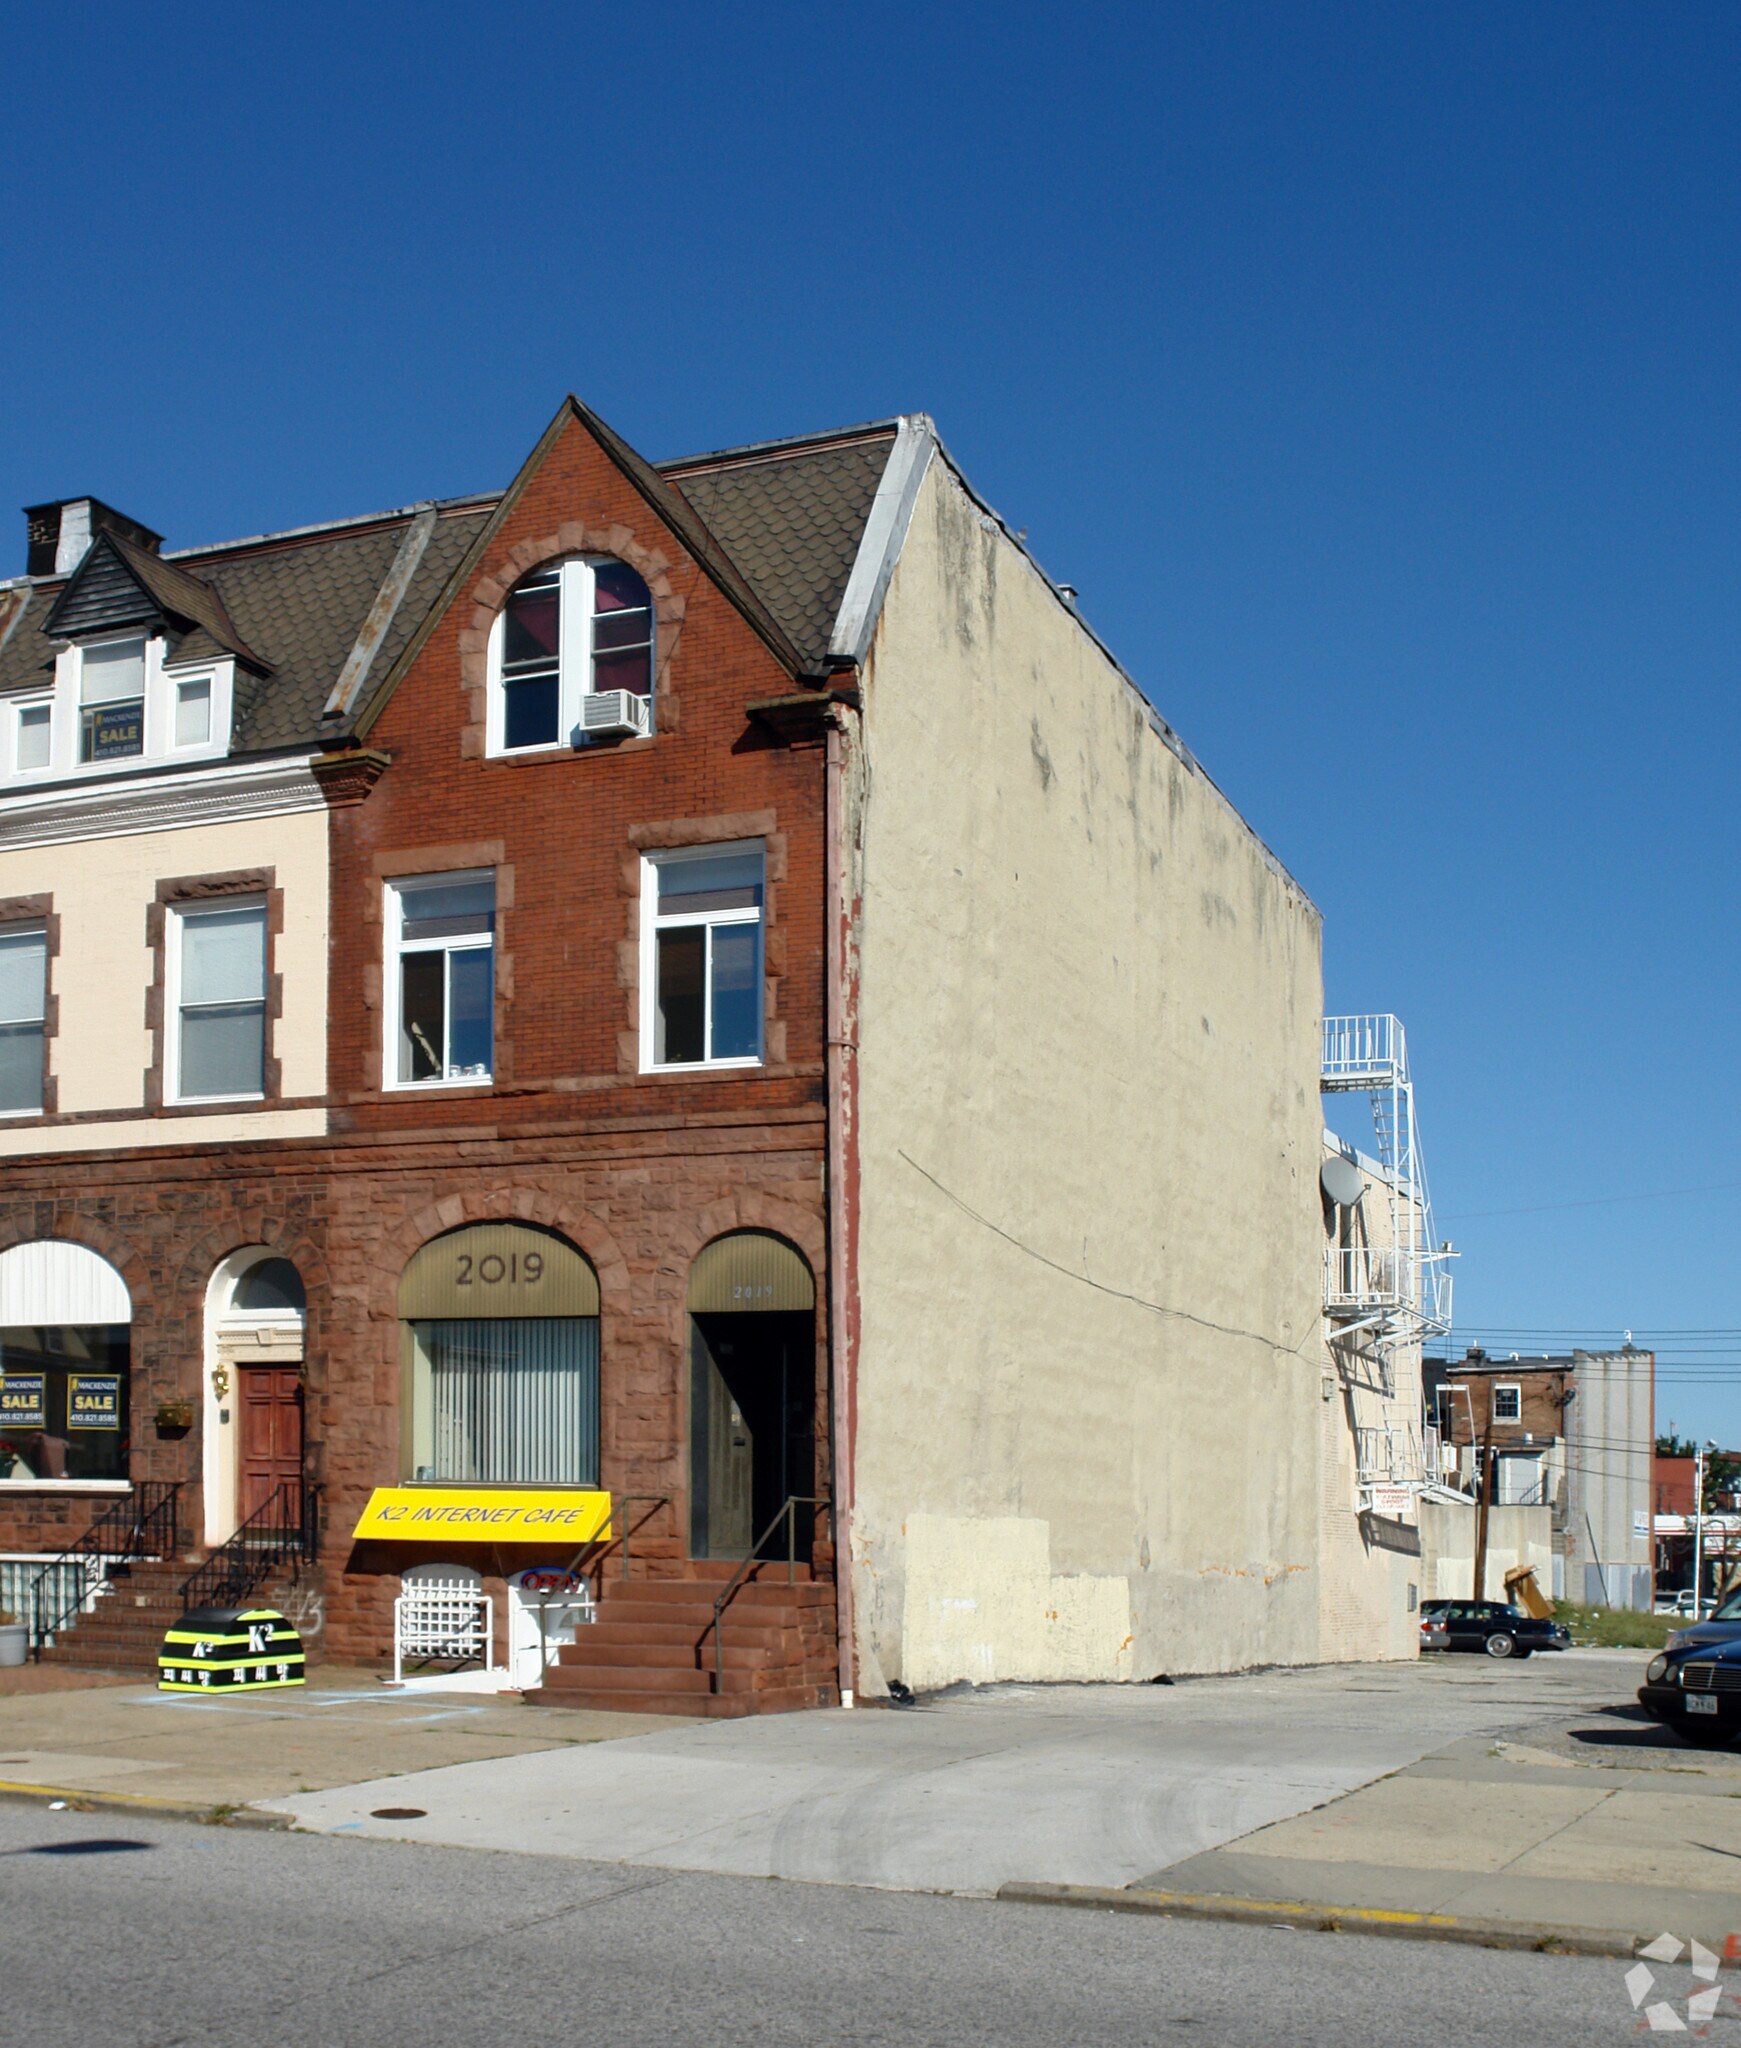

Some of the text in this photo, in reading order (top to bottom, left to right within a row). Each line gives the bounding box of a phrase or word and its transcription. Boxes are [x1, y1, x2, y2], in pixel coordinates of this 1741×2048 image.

[99, 726, 138, 744] SALE
[455, 1252, 544, 1285] 2019
[733, 1285, 773, 1299] 2019
[5, 1380, 42, 1389] MACKENZIE
[78, 1382, 117, 1390] MACKENZIE
[1, 1394, 40, 1409] SALE
[74, 1395, 114, 1410] SALE
[70, 1413, 117, 1422] 410.821.8585
[376, 1504, 585, 1524] K2 INTERNET CAFÉ
[522, 1573, 581, 1594] OPEN
